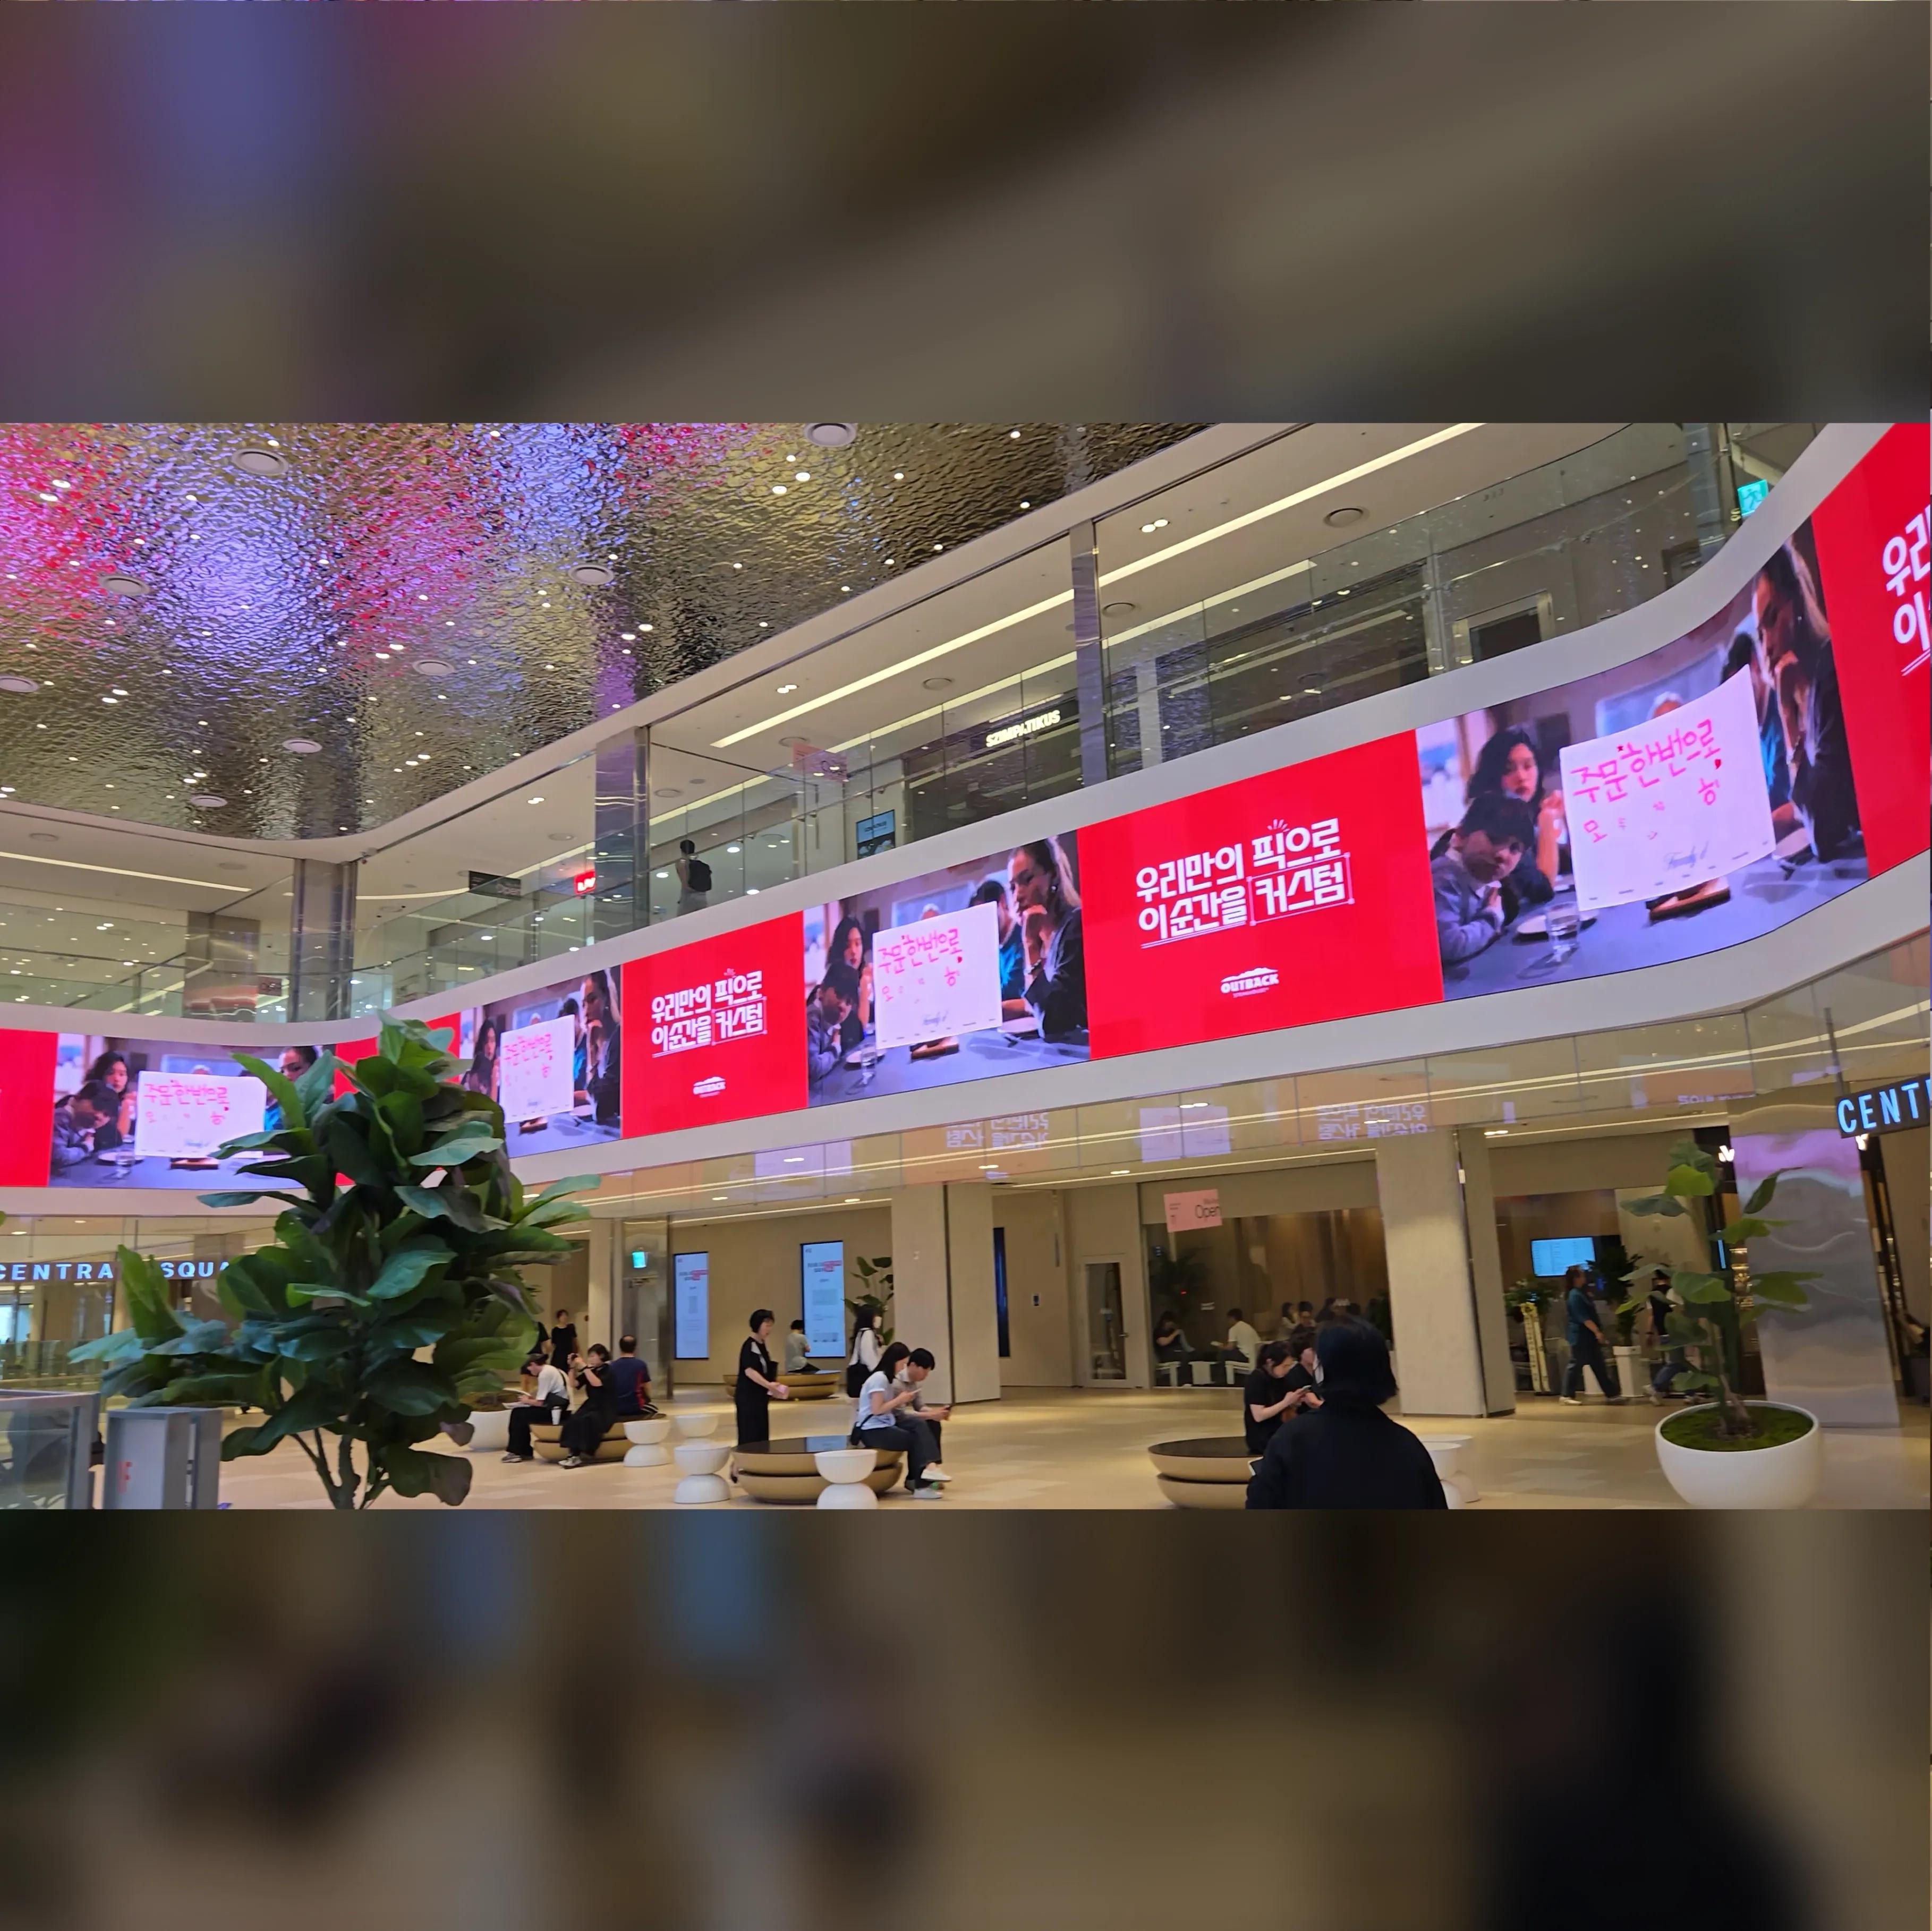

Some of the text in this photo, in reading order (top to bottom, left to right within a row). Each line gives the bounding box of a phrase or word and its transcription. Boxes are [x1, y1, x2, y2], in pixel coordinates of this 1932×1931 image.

[1136, 818, 1341, 903] 우리만의 픽으로
[1255, 862, 1346, 915] 커스텀
[651, 970, 762, 1023] 우리만의 픽으로
[1221, 973, 1280, 994] OUTBACK
[715, 1002, 763, 1039] 커스텀
[1837, 1079, 1930, 1133] CENT
[0, 1263, 114, 1280] ENTRA
